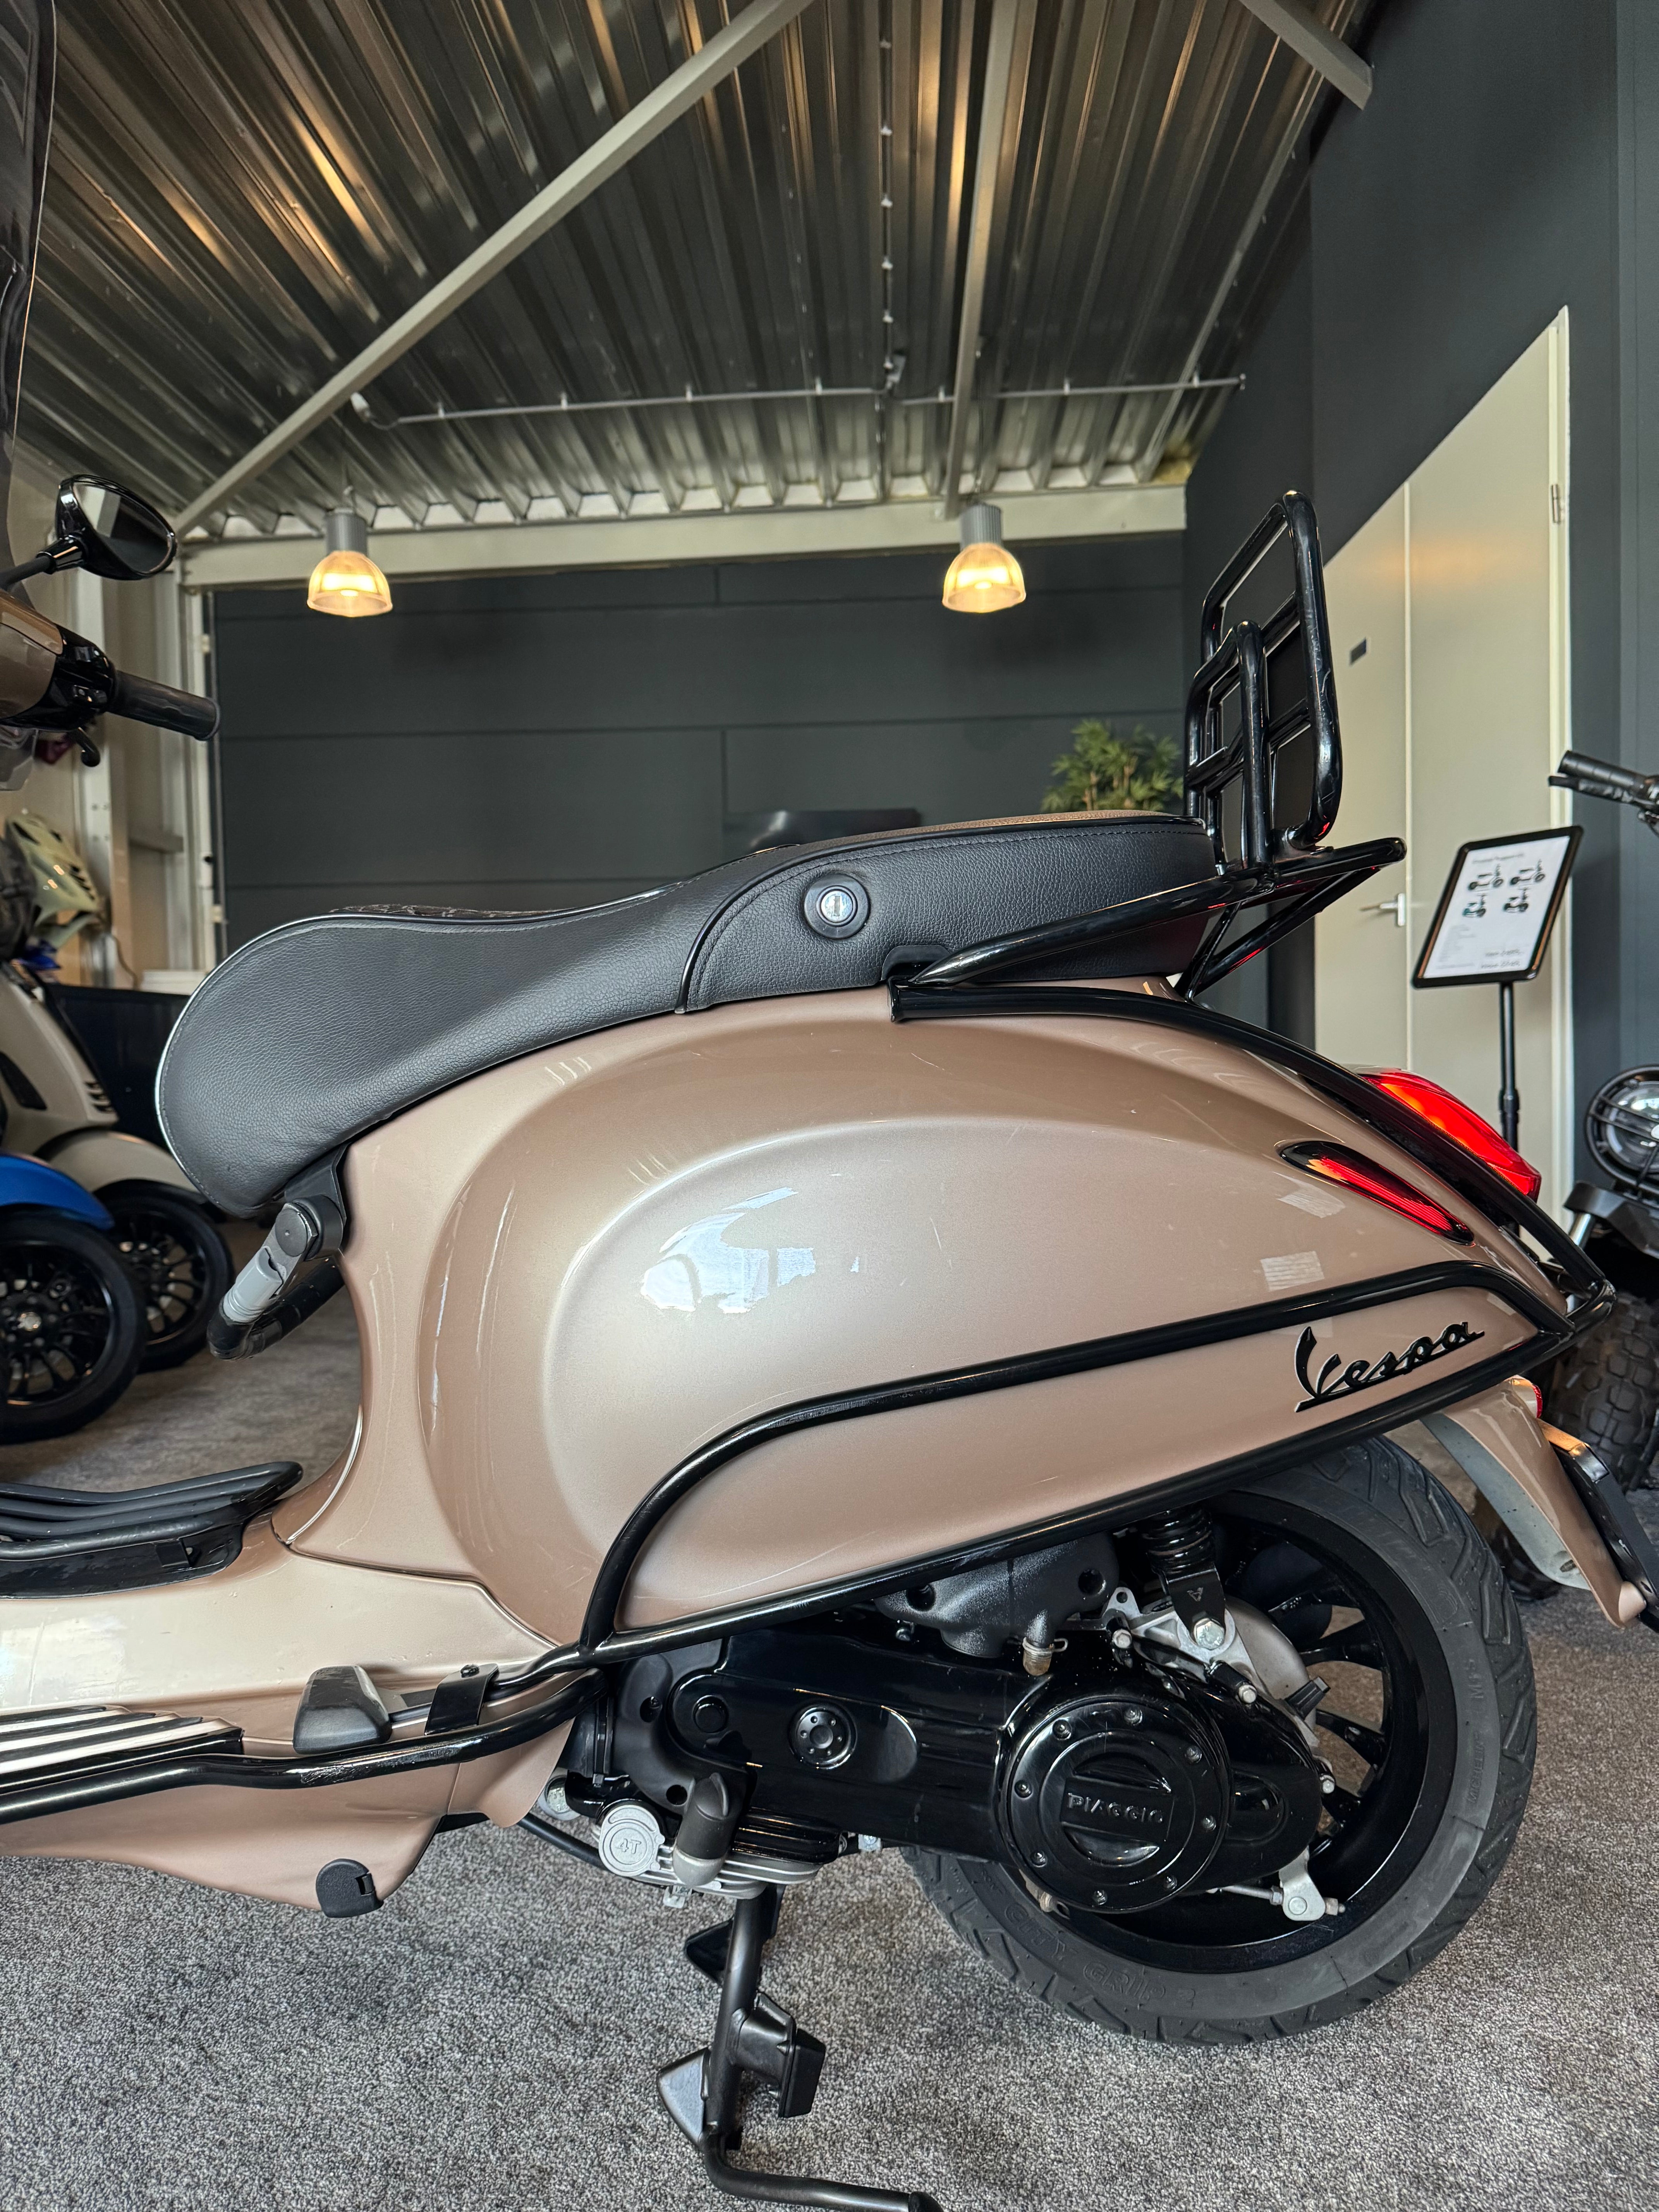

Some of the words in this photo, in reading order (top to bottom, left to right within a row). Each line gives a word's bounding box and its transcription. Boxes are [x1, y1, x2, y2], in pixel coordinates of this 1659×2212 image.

[1294, 1321, 1486, 1413] Vespa
[1068, 1793, 1163, 1823] PIAGGIO
[615, 1838, 642, 1855] 4T
[1004, 1902, 1078, 1961] CITY
[1083, 1962, 1166, 2001] GRIP
